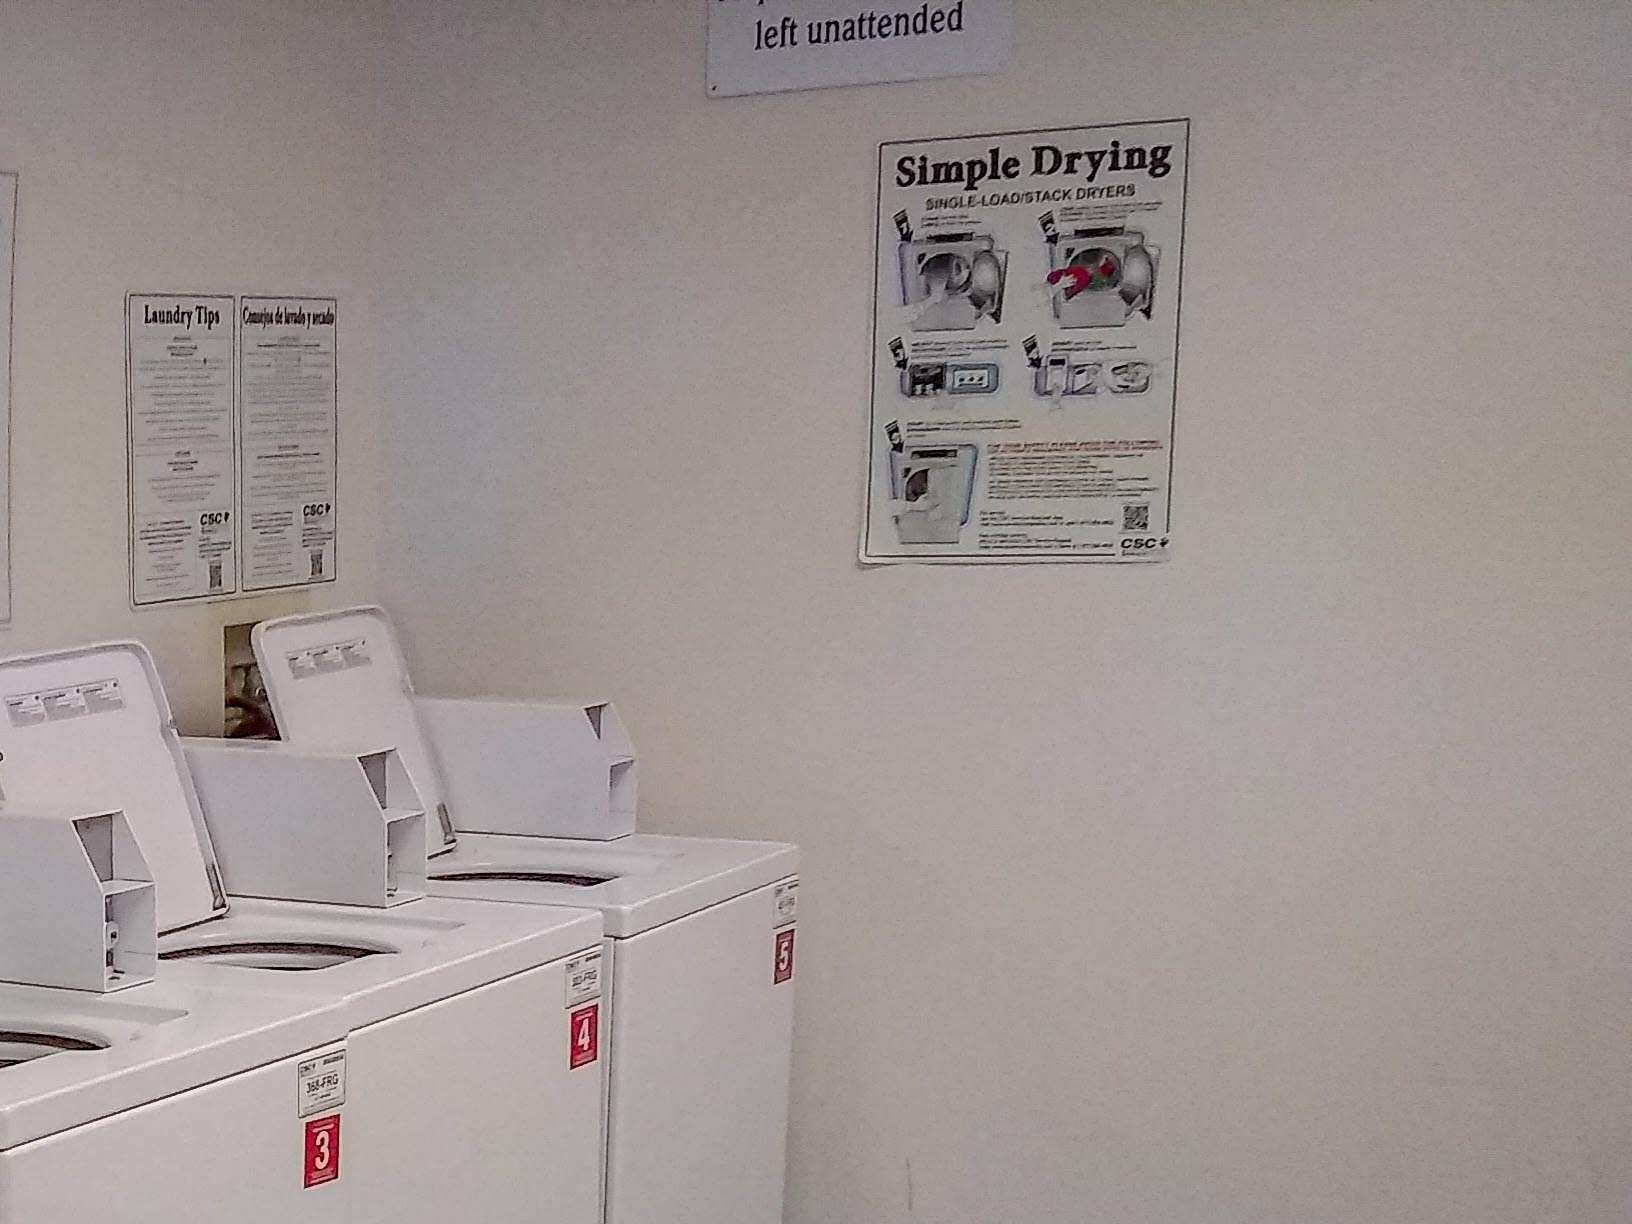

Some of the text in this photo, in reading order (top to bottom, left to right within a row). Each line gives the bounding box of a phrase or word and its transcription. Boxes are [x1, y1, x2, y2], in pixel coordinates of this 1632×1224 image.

[754, 1, 963, 50] left unattended
[896, 140, 1172, 190] Simple Drying
[1076, 183, 1136, 200] DRYERS
[144, 304, 220, 330] Laundry Tips
[200, 512, 222, 526] CSC
[303, 503, 324, 517] CSC
[1120, 538, 1156, 549] CSC
[577, 1018, 590, 1051] 4
[314, 1130, 330, 1170] 3
